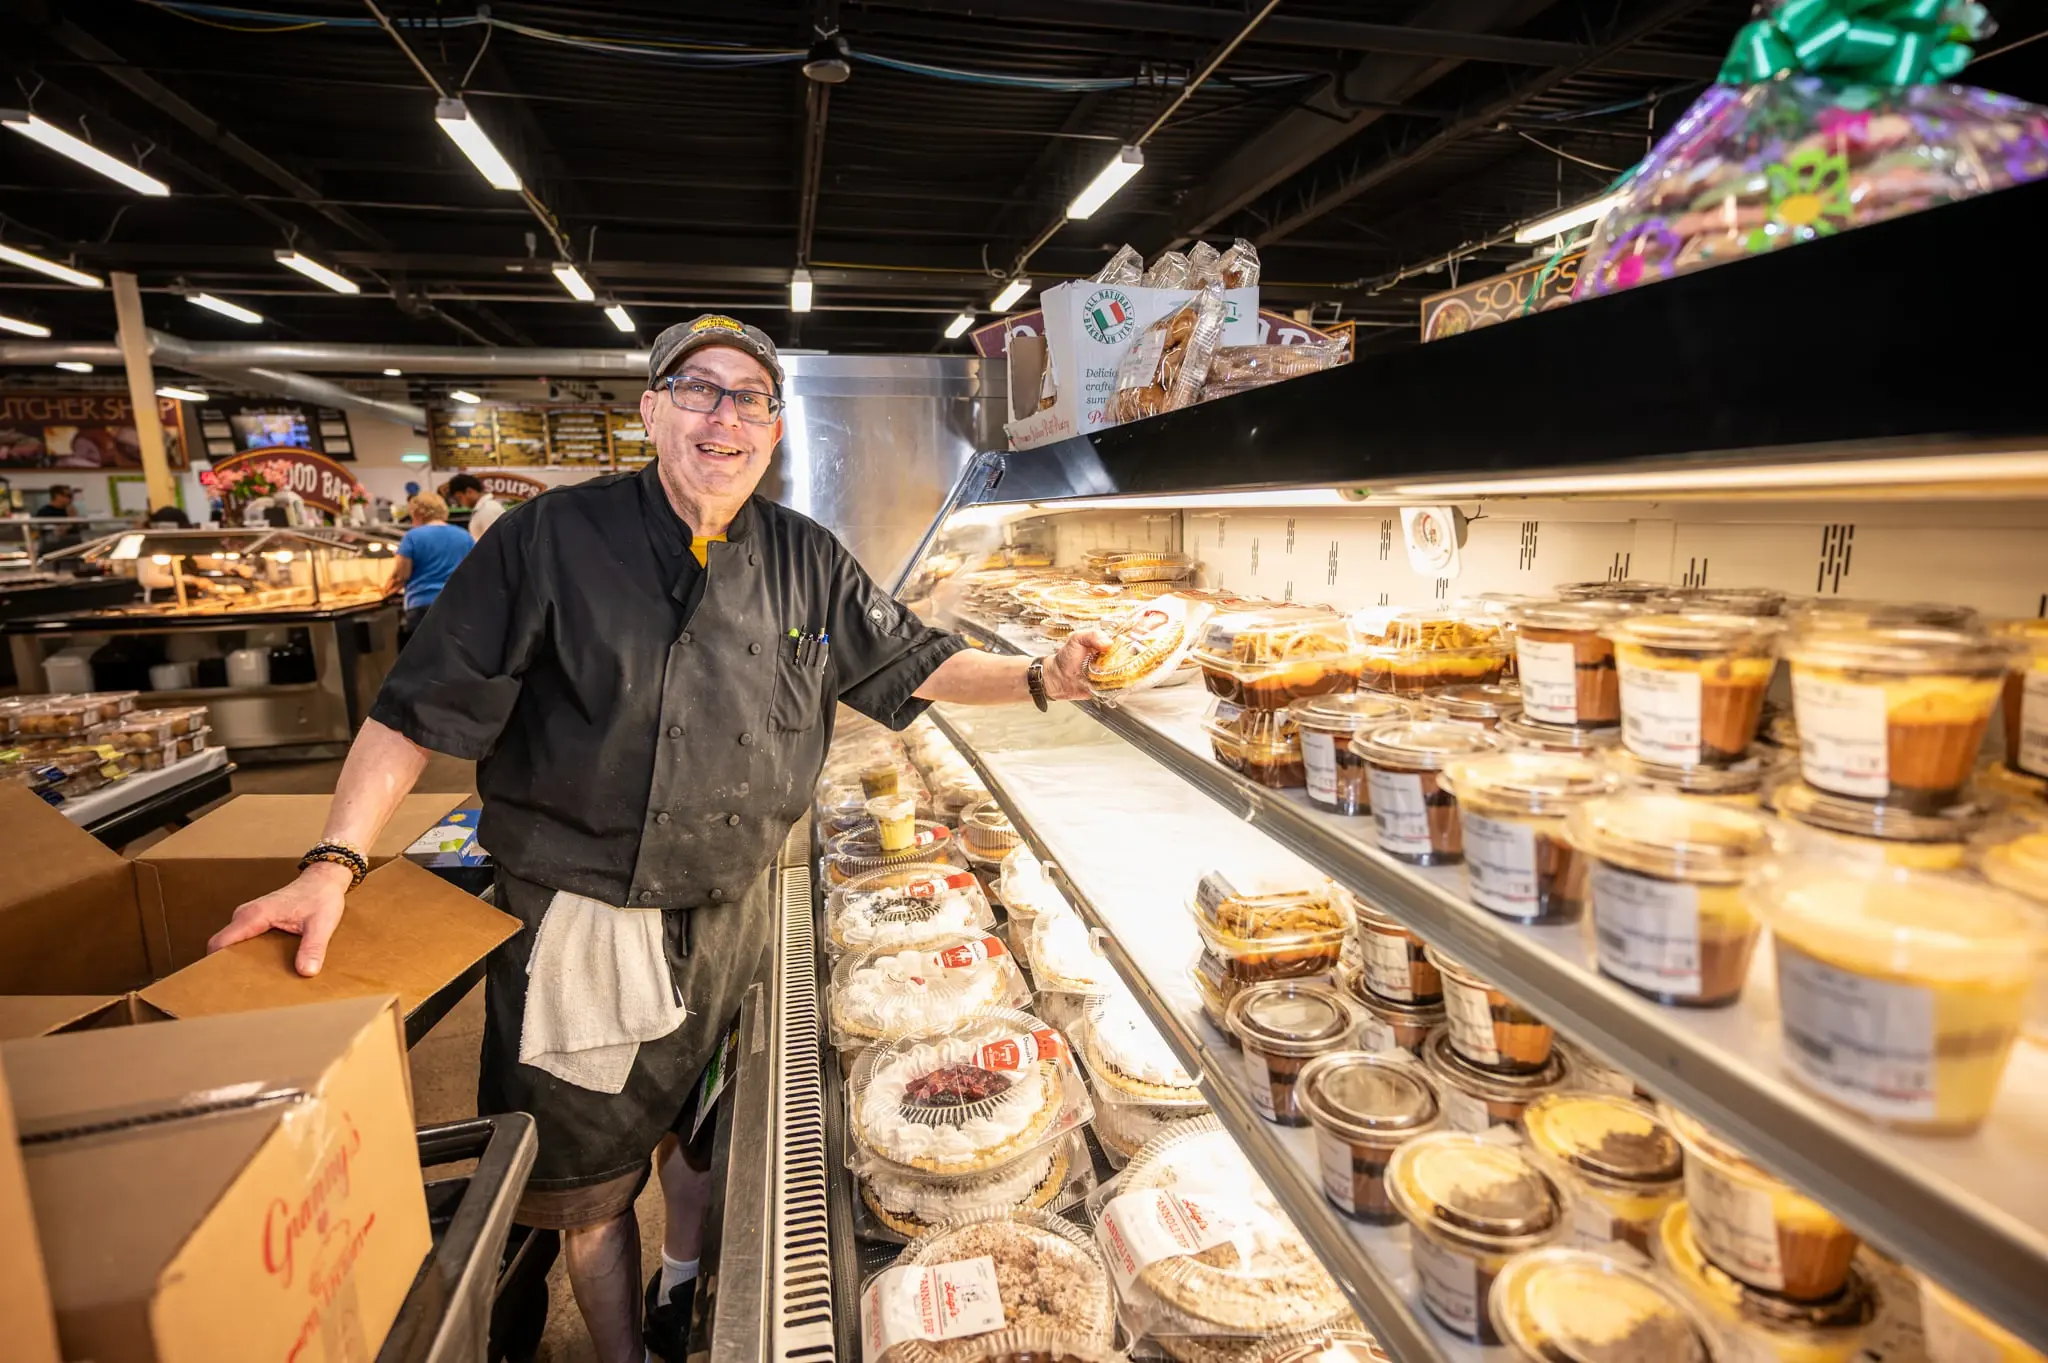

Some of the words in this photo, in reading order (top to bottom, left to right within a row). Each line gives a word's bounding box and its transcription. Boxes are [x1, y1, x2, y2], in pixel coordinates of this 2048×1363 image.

[1473, 260, 1577, 316] SOUPS
[1085, 296, 1097, 312] ALL
[1099, 290, 1131, 311] NATURAL
[1084, 318, 1104, 342] BAKED
[1119, 317, 1133, 340] ITALY
[1085, 381, 1115, 393] crafte
[103, 398, 175, 421] SHP
[322, 471, 352, 503] BAR
[483, 477, 540, 497] SOUPS
[1181, 1198, 1208, 1231] Luigi's
[944, 1281, 961, 1318] Luigi's
